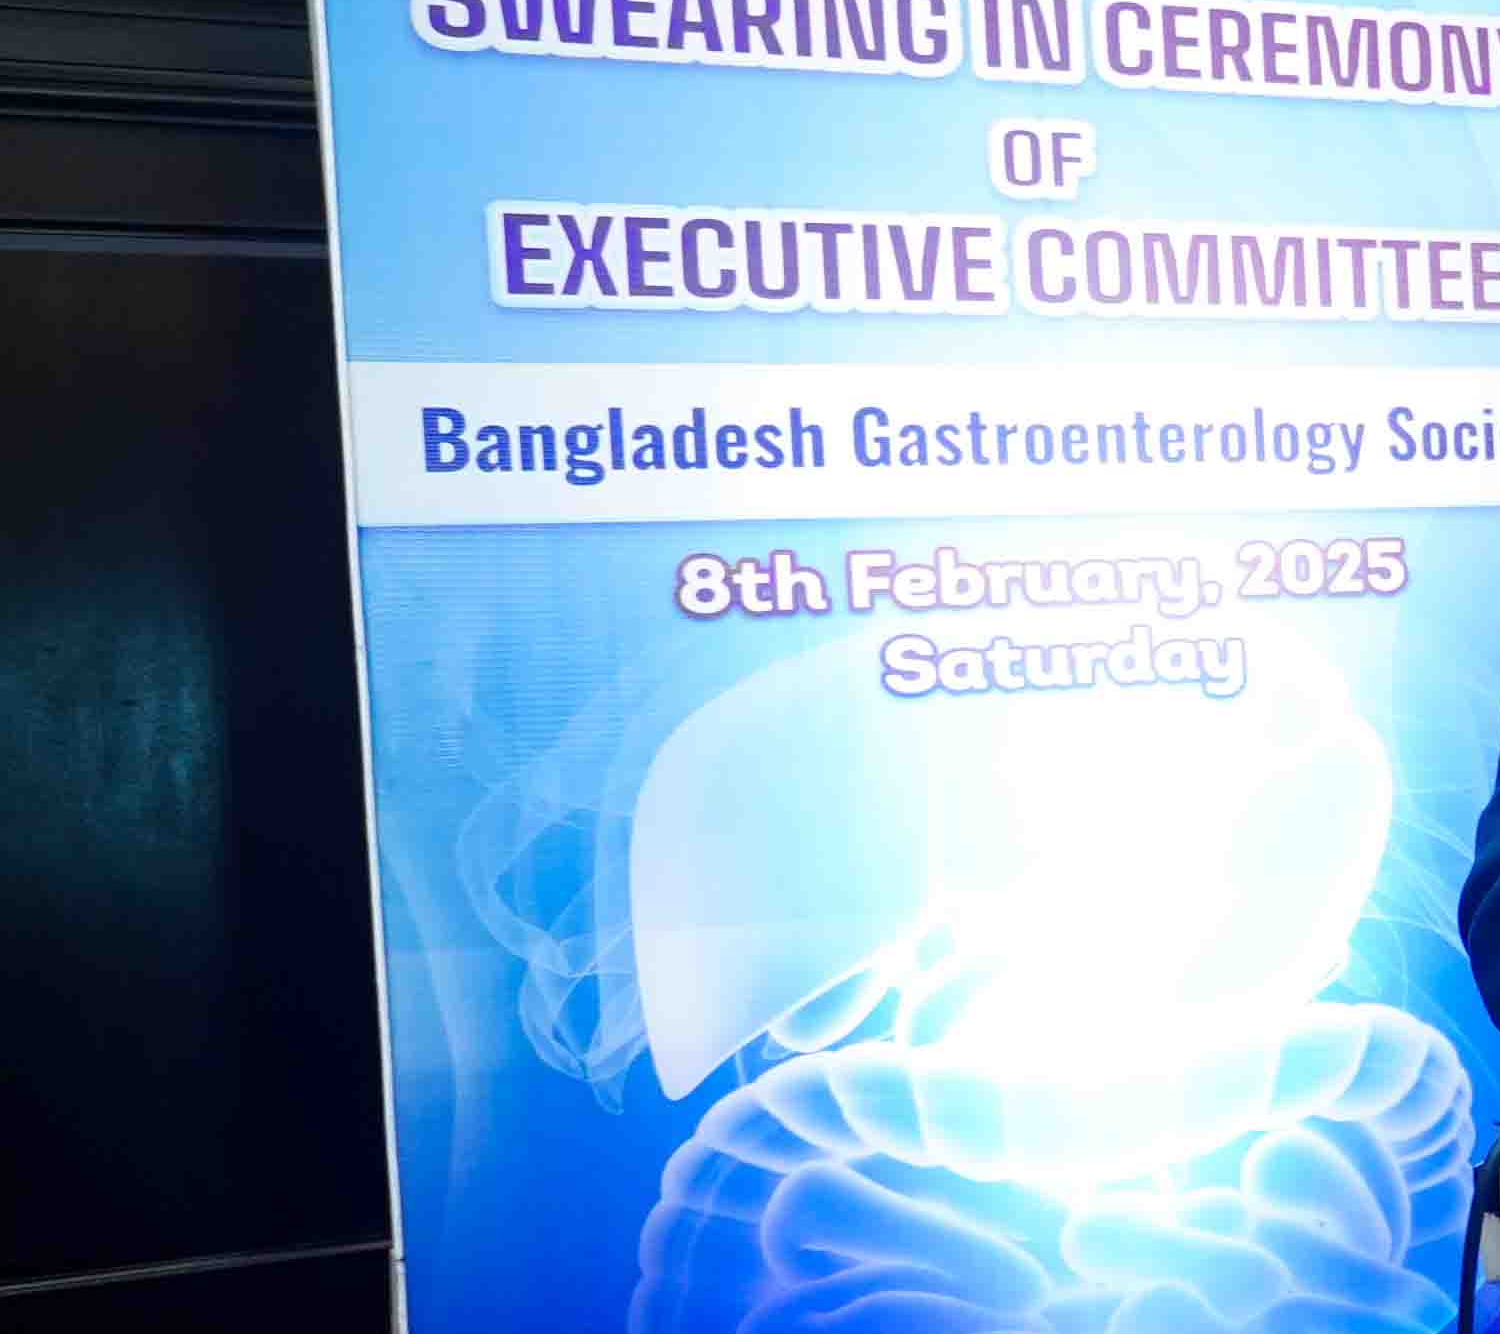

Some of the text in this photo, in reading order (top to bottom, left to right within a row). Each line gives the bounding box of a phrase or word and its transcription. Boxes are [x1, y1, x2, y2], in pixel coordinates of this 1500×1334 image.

[1002, 128, 1085, 189] OF
[502, 211, 994, 304] EXECUTIVE
[422, 404, 826, 488] Bangladesh
[853, 406, 1365, 474] Gastroenterology
[677, 535, 1409, 618] 8th February, 2025
[881, 623, 1246, 699] Saturday
